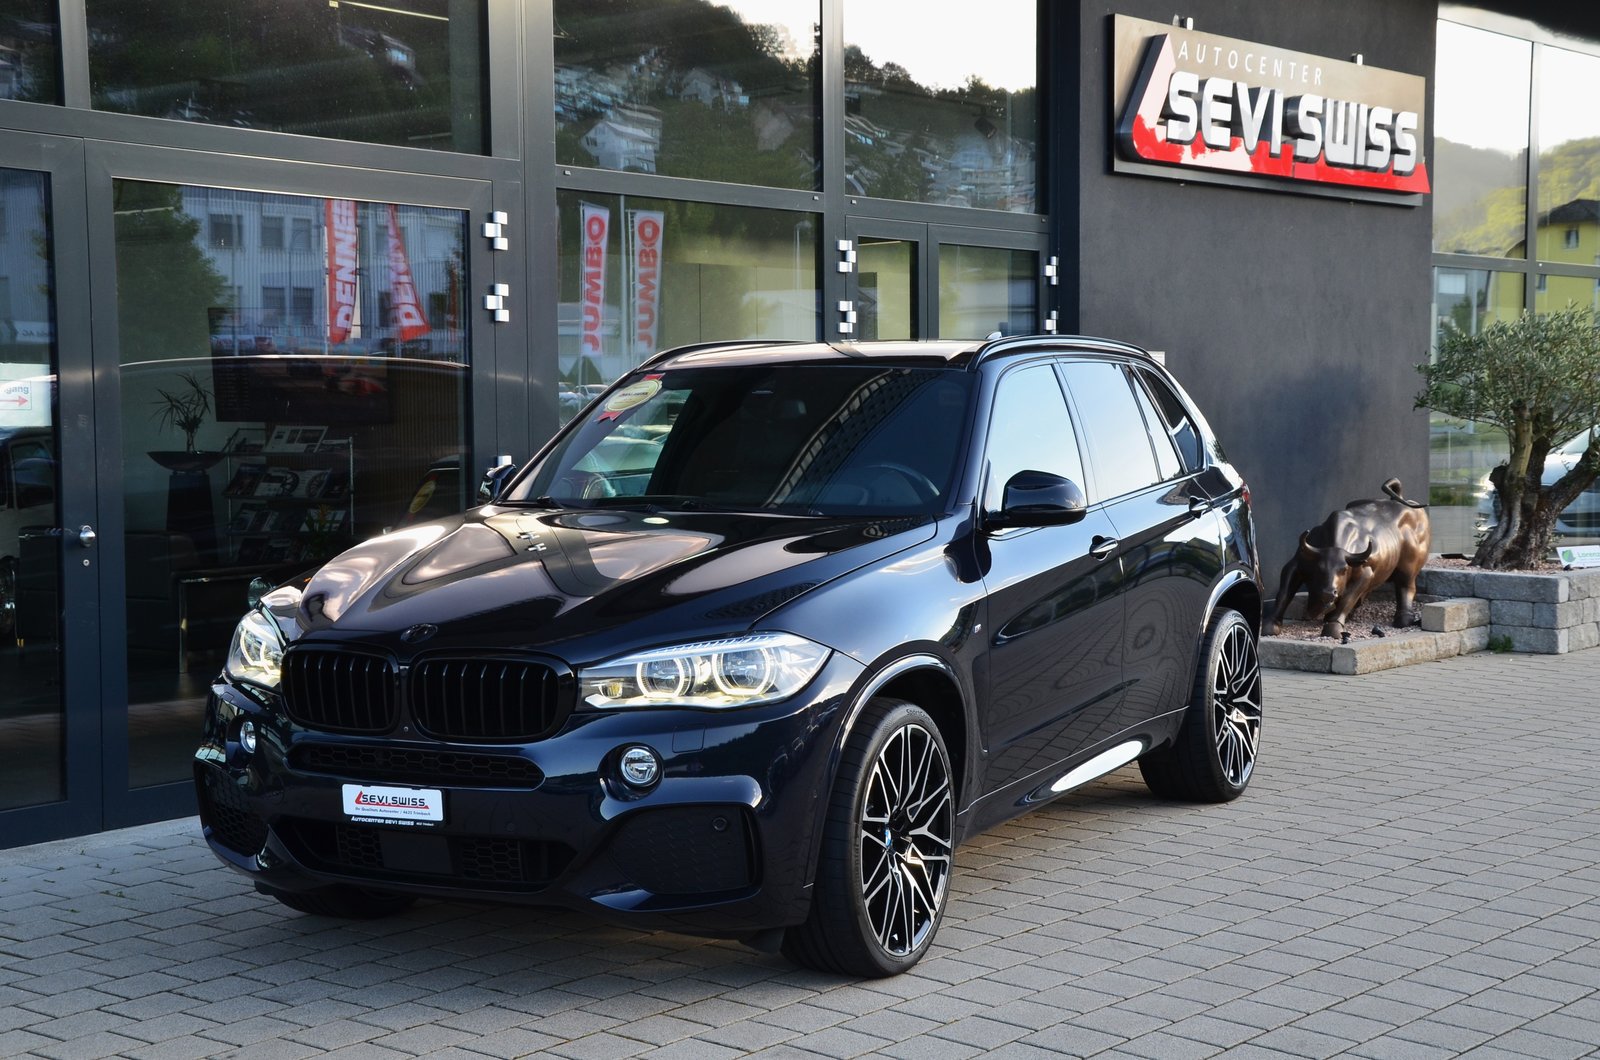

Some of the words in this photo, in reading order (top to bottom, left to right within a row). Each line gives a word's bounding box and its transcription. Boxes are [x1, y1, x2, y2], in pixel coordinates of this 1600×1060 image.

[1178, 40, 1324, 86] AUTOCENTER
[1166, 71, 1285, 156] SEVI
[1294, 93, 1418, 173] SWISS
[582, 214, 606, 352] JUMBO
[637, 218, 660, 349] JUMBO
[362, 794, 388, 803] SEVI
[391, 796, 426, 807] SWISS
